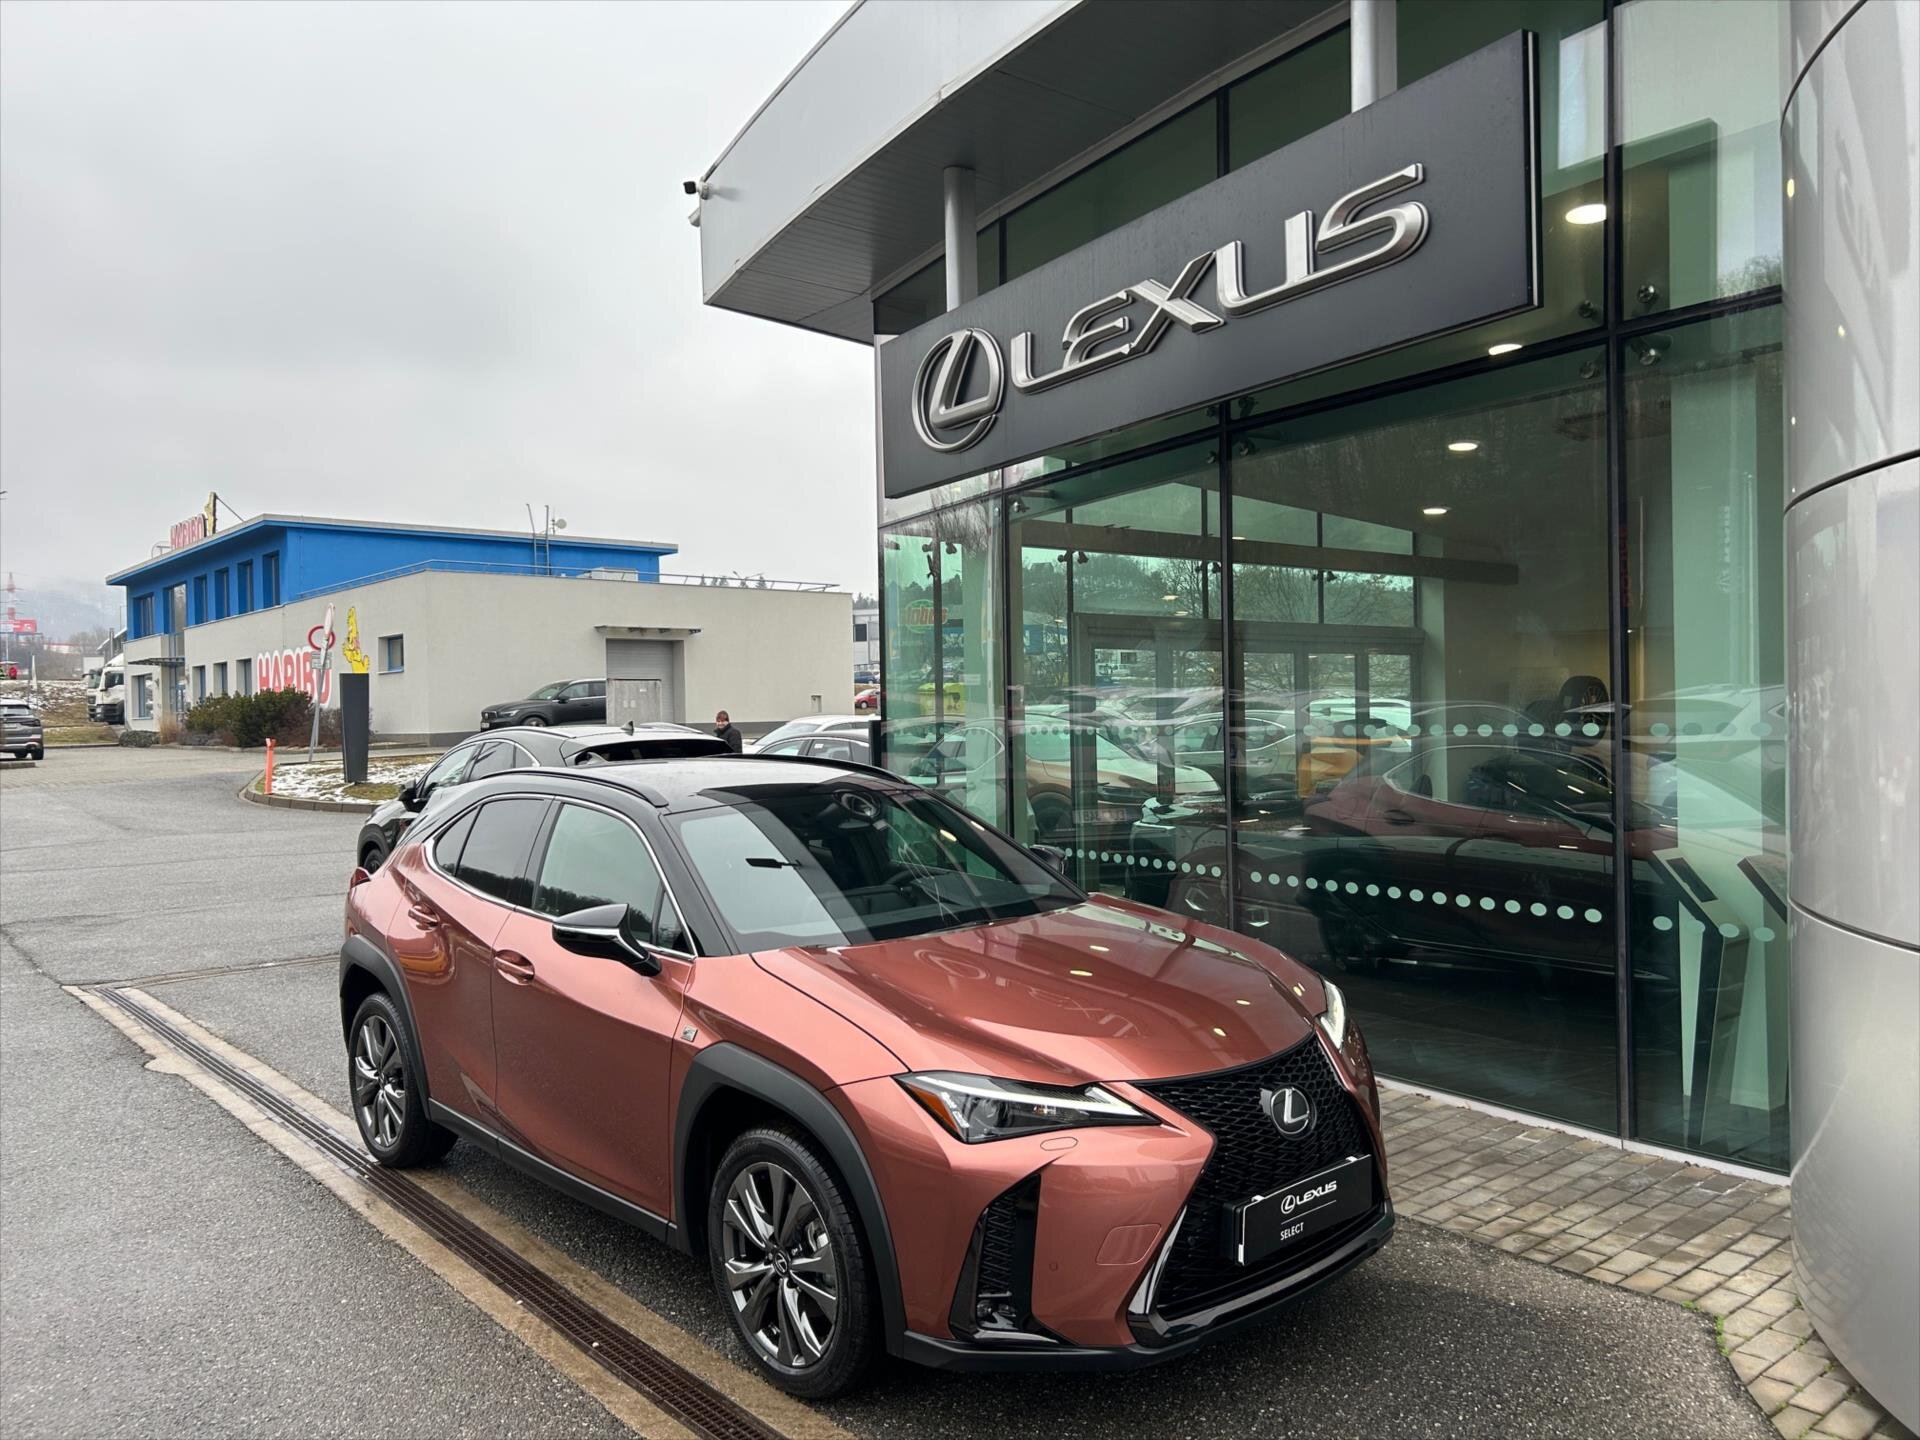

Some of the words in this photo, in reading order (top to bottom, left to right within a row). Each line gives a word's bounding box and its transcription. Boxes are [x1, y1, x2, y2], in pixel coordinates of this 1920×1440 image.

[1010, 162, 1431, 395] LEXUS
[1296, 1180, 1338, 1205] LEXUS
[1280, 1222, 1305, 1241] SELECT
